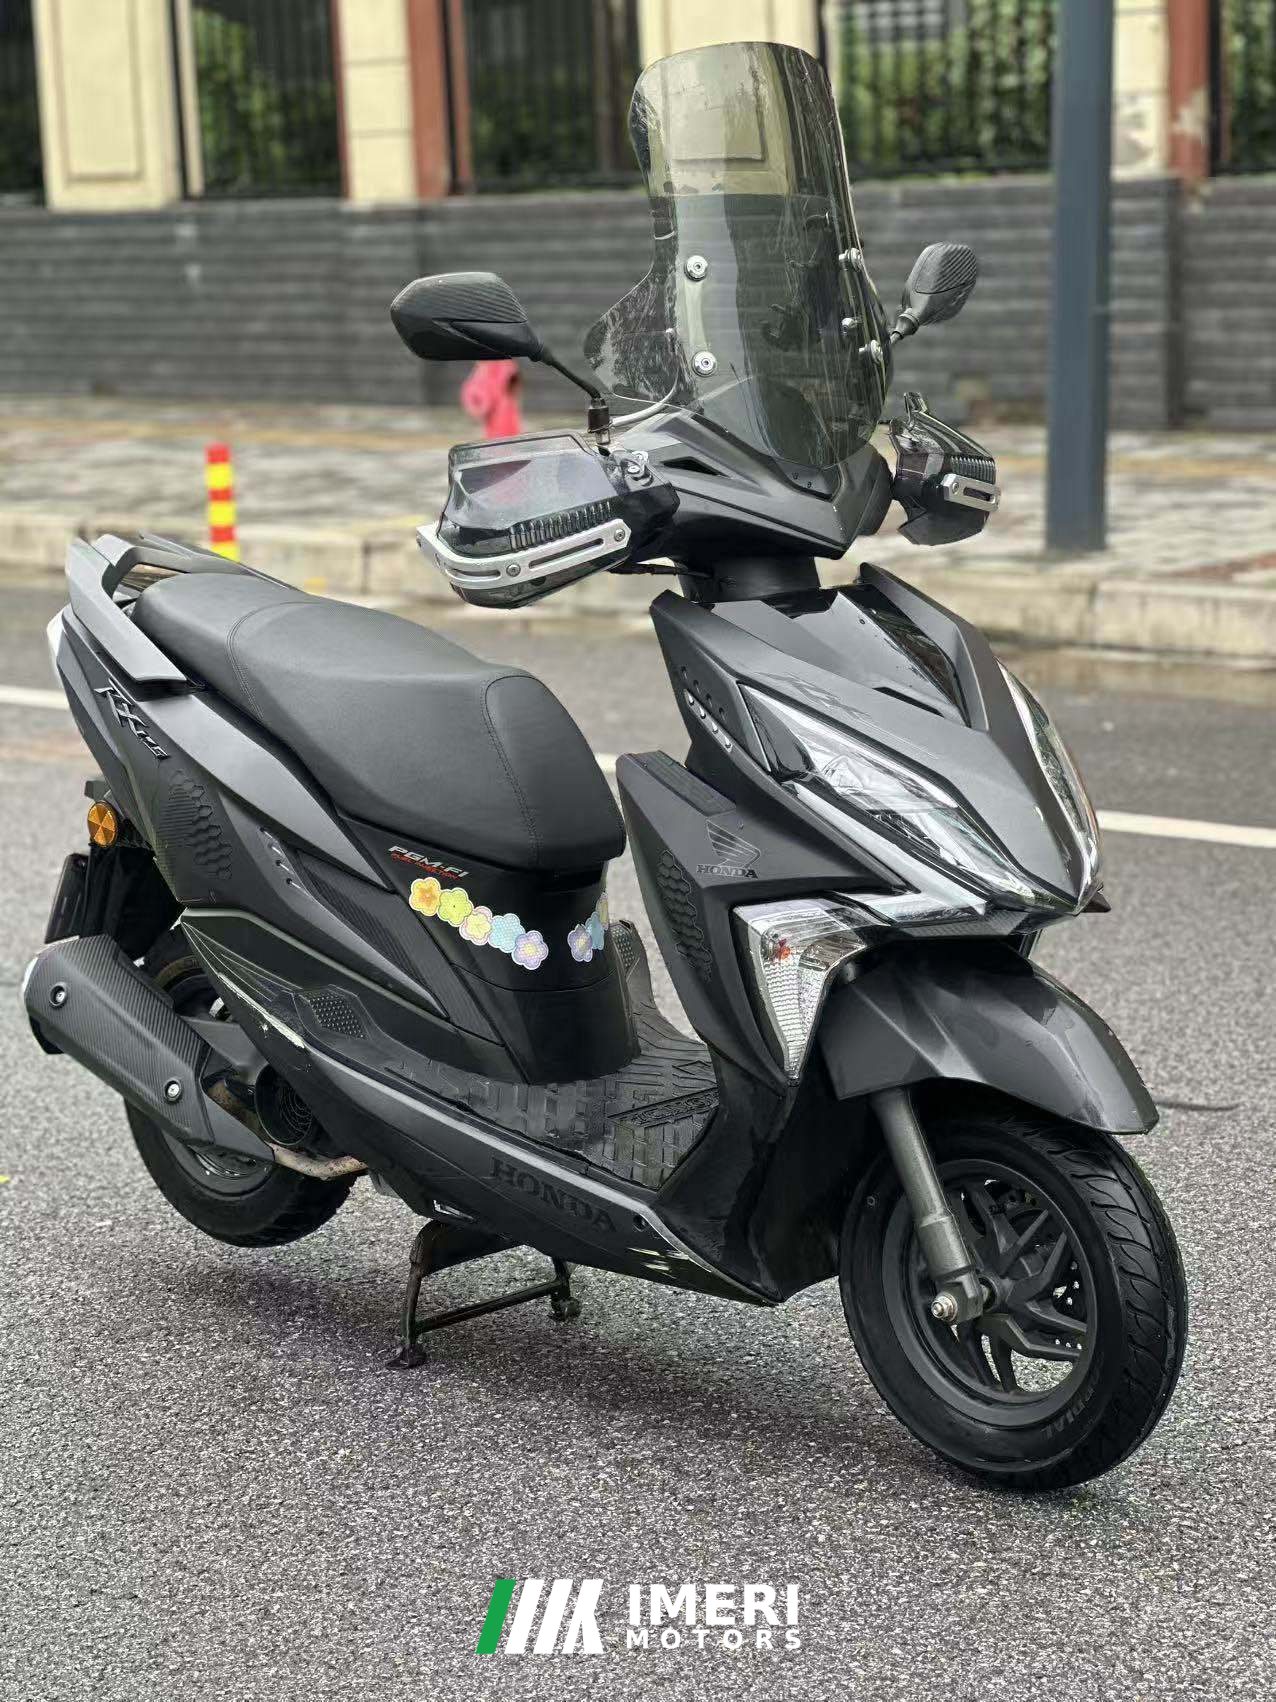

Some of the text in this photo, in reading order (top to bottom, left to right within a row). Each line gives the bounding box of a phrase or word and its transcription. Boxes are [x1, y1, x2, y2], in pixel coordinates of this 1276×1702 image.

[388, 845, 469, 877] PGM-FI
[696, 864, 759, 879] HONDA
[490, 1156, 618, 1233] HONDA
